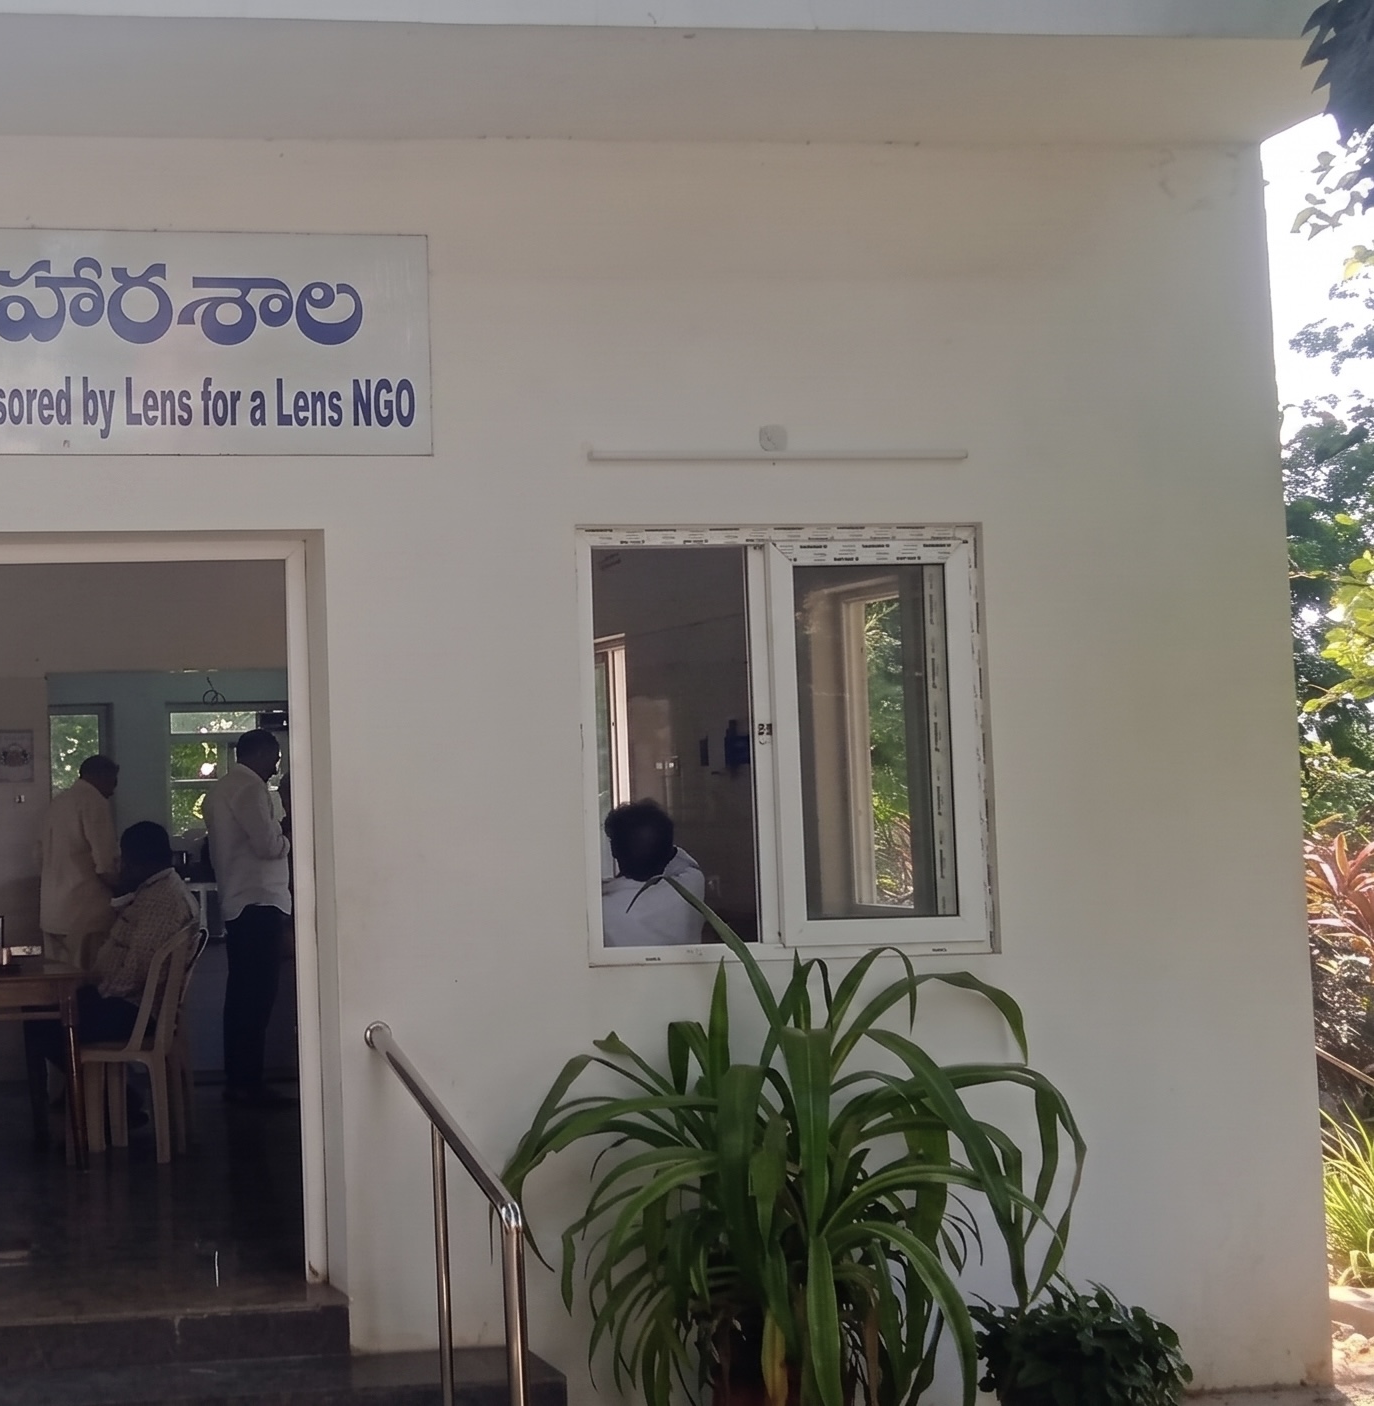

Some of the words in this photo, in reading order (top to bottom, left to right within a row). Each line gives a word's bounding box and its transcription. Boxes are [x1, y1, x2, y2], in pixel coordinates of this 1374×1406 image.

[82, 376, 116, 439] by
[125, 376, 193, 427] Lens
[200, 376, 242, 427] for
[249, 390, 267, 427] a
[276, 377, 343, 428] Lens
[352, 378, 416, 428] NGO
